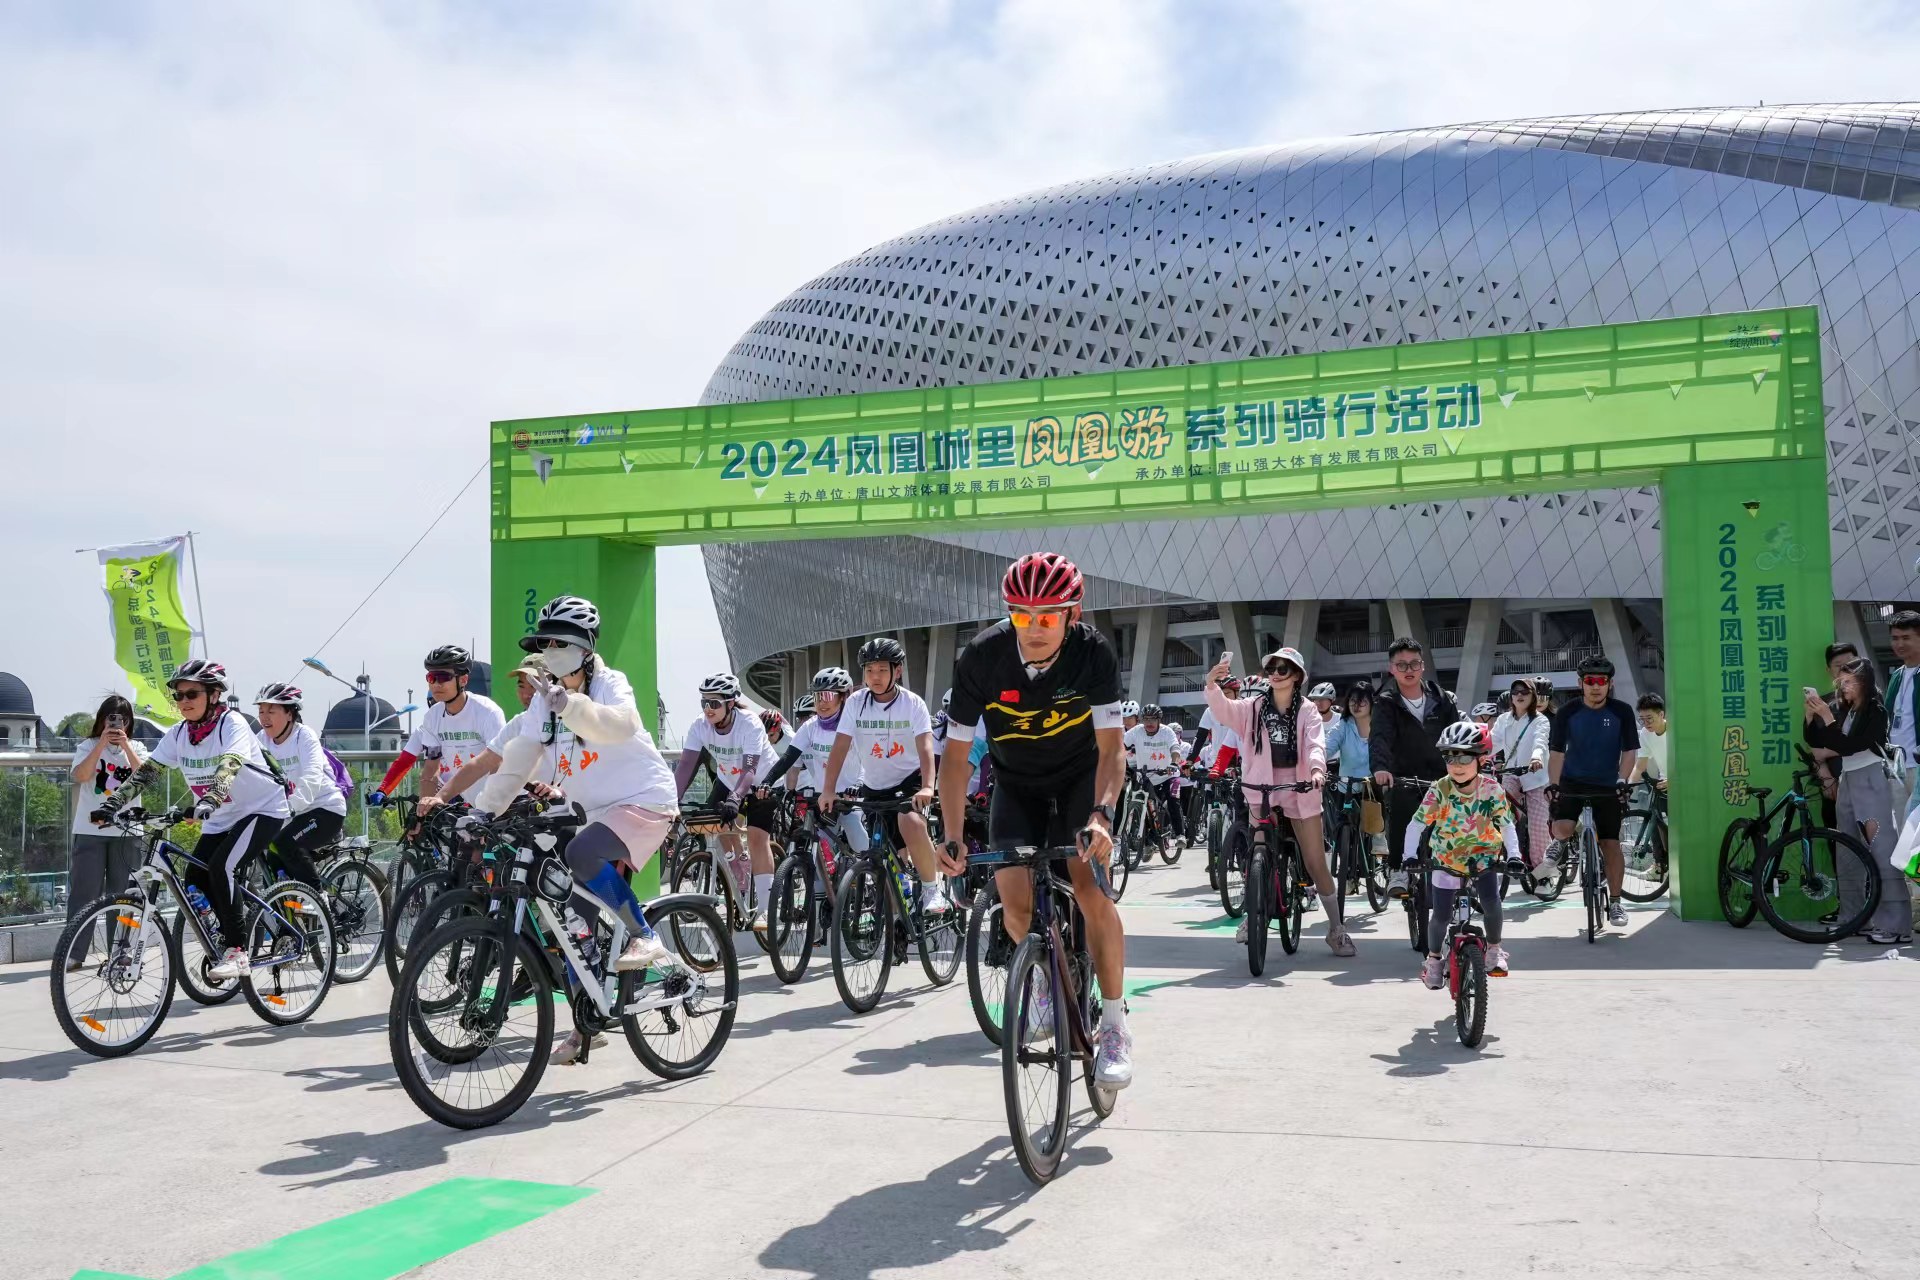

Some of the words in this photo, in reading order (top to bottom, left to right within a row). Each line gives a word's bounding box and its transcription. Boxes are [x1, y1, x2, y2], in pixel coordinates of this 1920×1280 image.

[1755, 583, 1792, 765] 系列骑行活动
